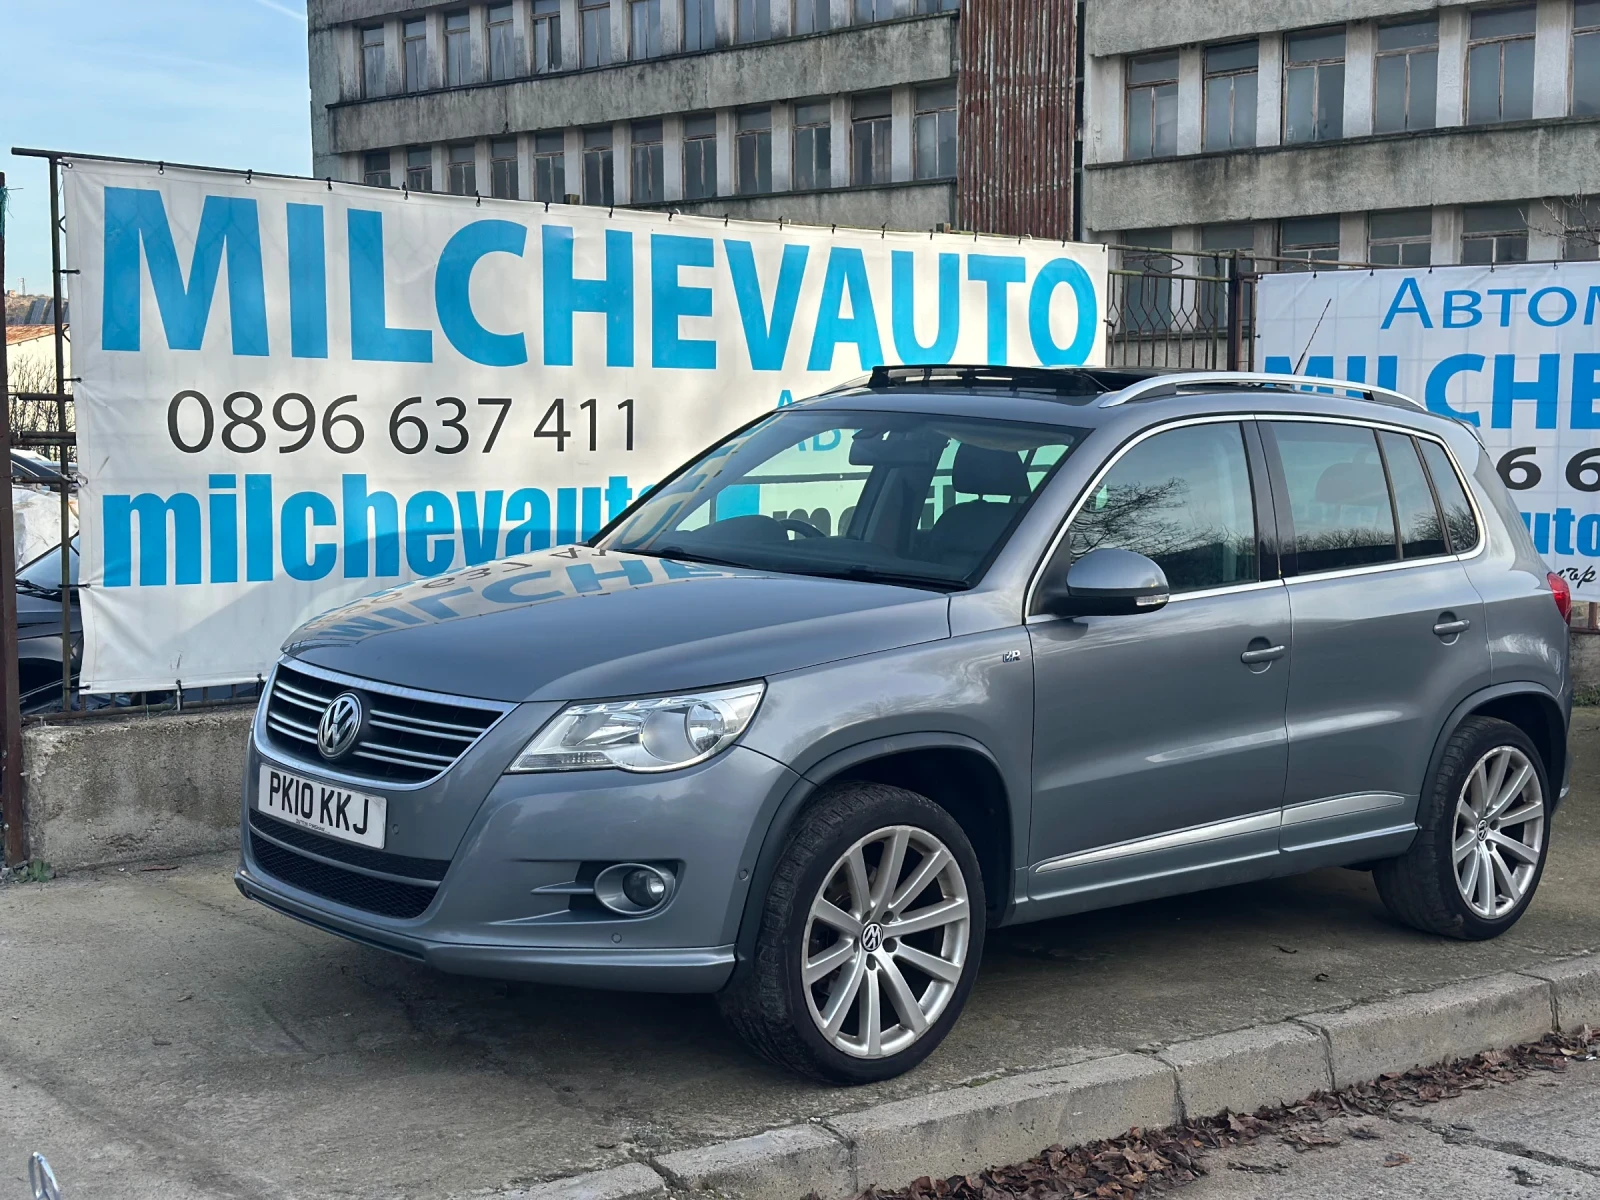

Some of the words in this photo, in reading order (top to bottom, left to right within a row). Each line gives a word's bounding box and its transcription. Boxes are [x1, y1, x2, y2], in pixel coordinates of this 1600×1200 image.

[102, 186, 1098, 371] MILCHEVAUTO
[166, 389, 365, 454] 0896
[388, 395, 513, 454] 637
[533, 397, 636, 452] 411
[102, 473, 659, 586] milchevaut
[268, 771, 314, 821] PK10
[319, 786, 370, 836] KKJ
